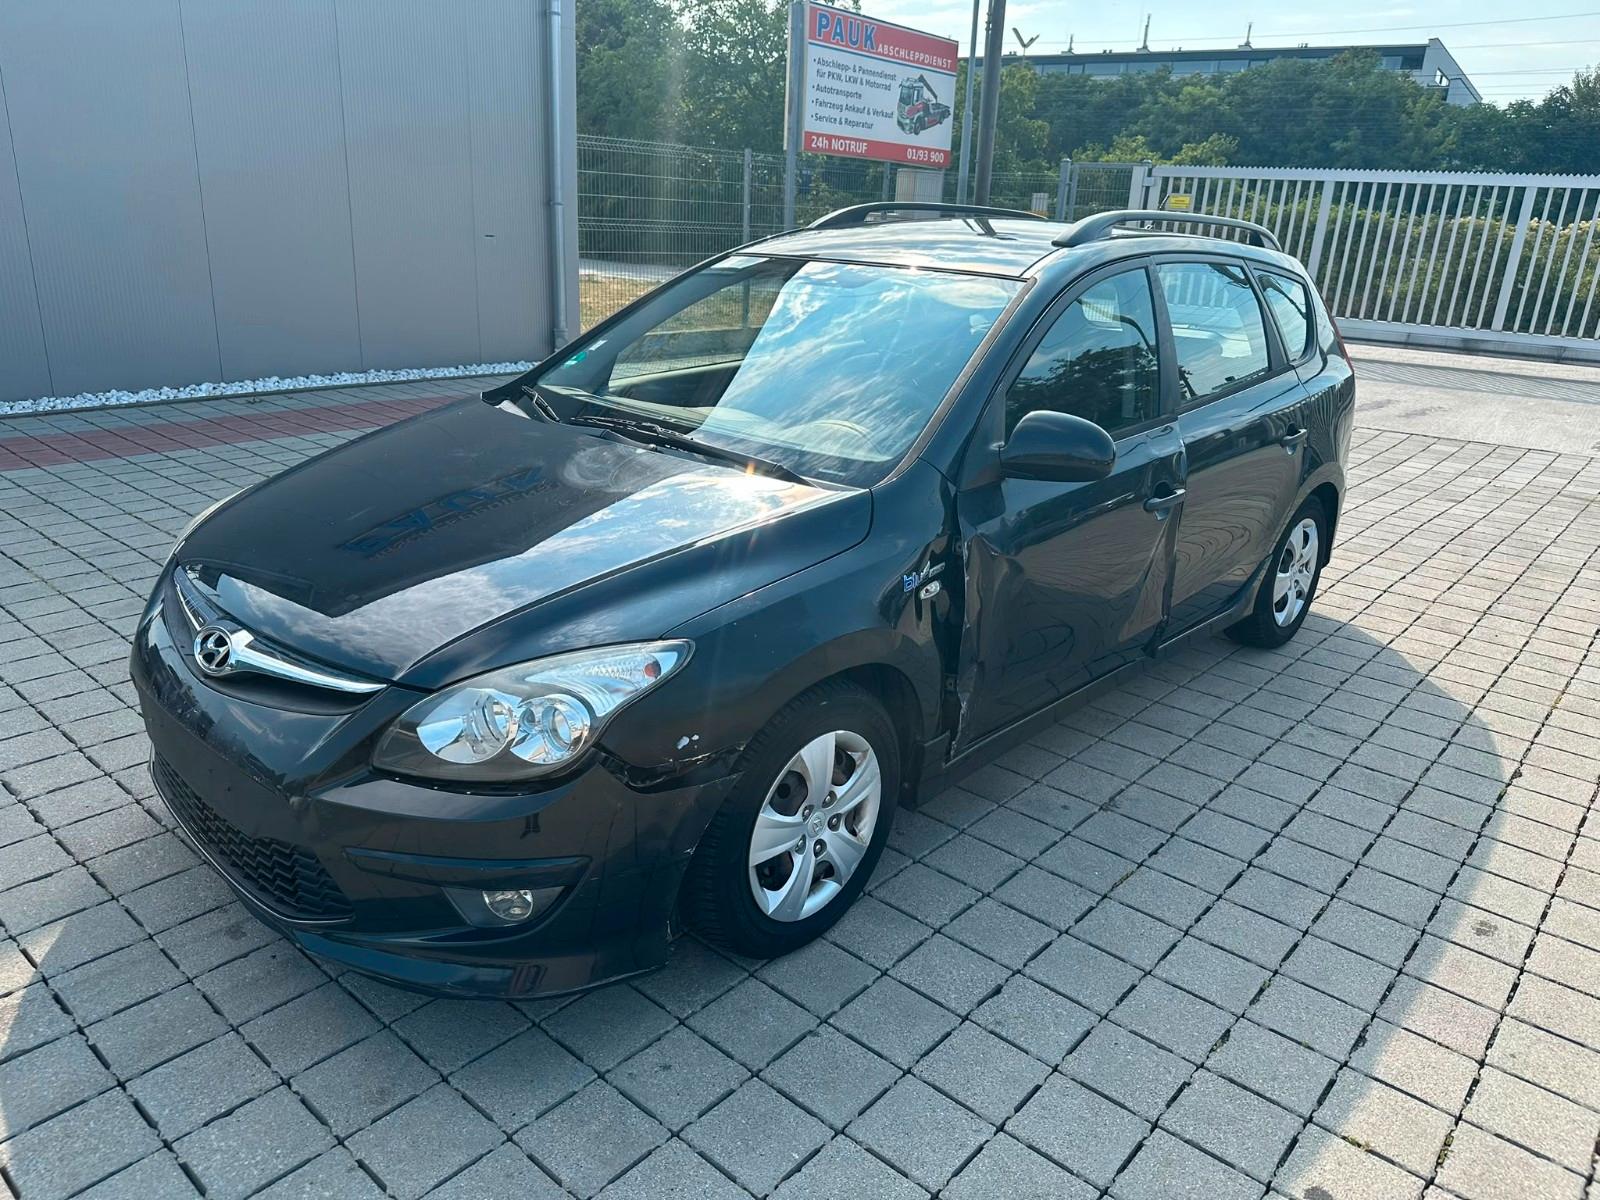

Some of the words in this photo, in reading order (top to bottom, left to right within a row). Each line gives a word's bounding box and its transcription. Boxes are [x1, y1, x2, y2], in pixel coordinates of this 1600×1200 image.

[816, 10, 877, 52] PAUK
[877, 43, 952, 69] ABSCHLEPPDIENST
[816, 68, 826, 78] für
[827, 70, 843, 82] PKW,
[844, 74, 859, 85] LKW
[859, 78, 864, 86] &
[865, 79, 892, 92] Motorrad
[852, 64, 857, 73] &
[858, 65, 897, 81] Pannendienst
[815, 83, 862, 100] Autotransporte
[815, 98, 844, 113] Fahrzeug
[844, 103, 866, 114] Ankauf
[866, 107, 871, 116] &
[872, 108, 894, 119] Verkauf
[814, 113, 837, 125] Service
[838, 117, 843, 126] &
[844, 117, 874, 130] Reparatur
[811, 135, 829, 149] 24h
[831, 138, 868, 154] NOTRUF
[906, 148, 928, 161] 01/93
[930, 152, 945, 163] 900
